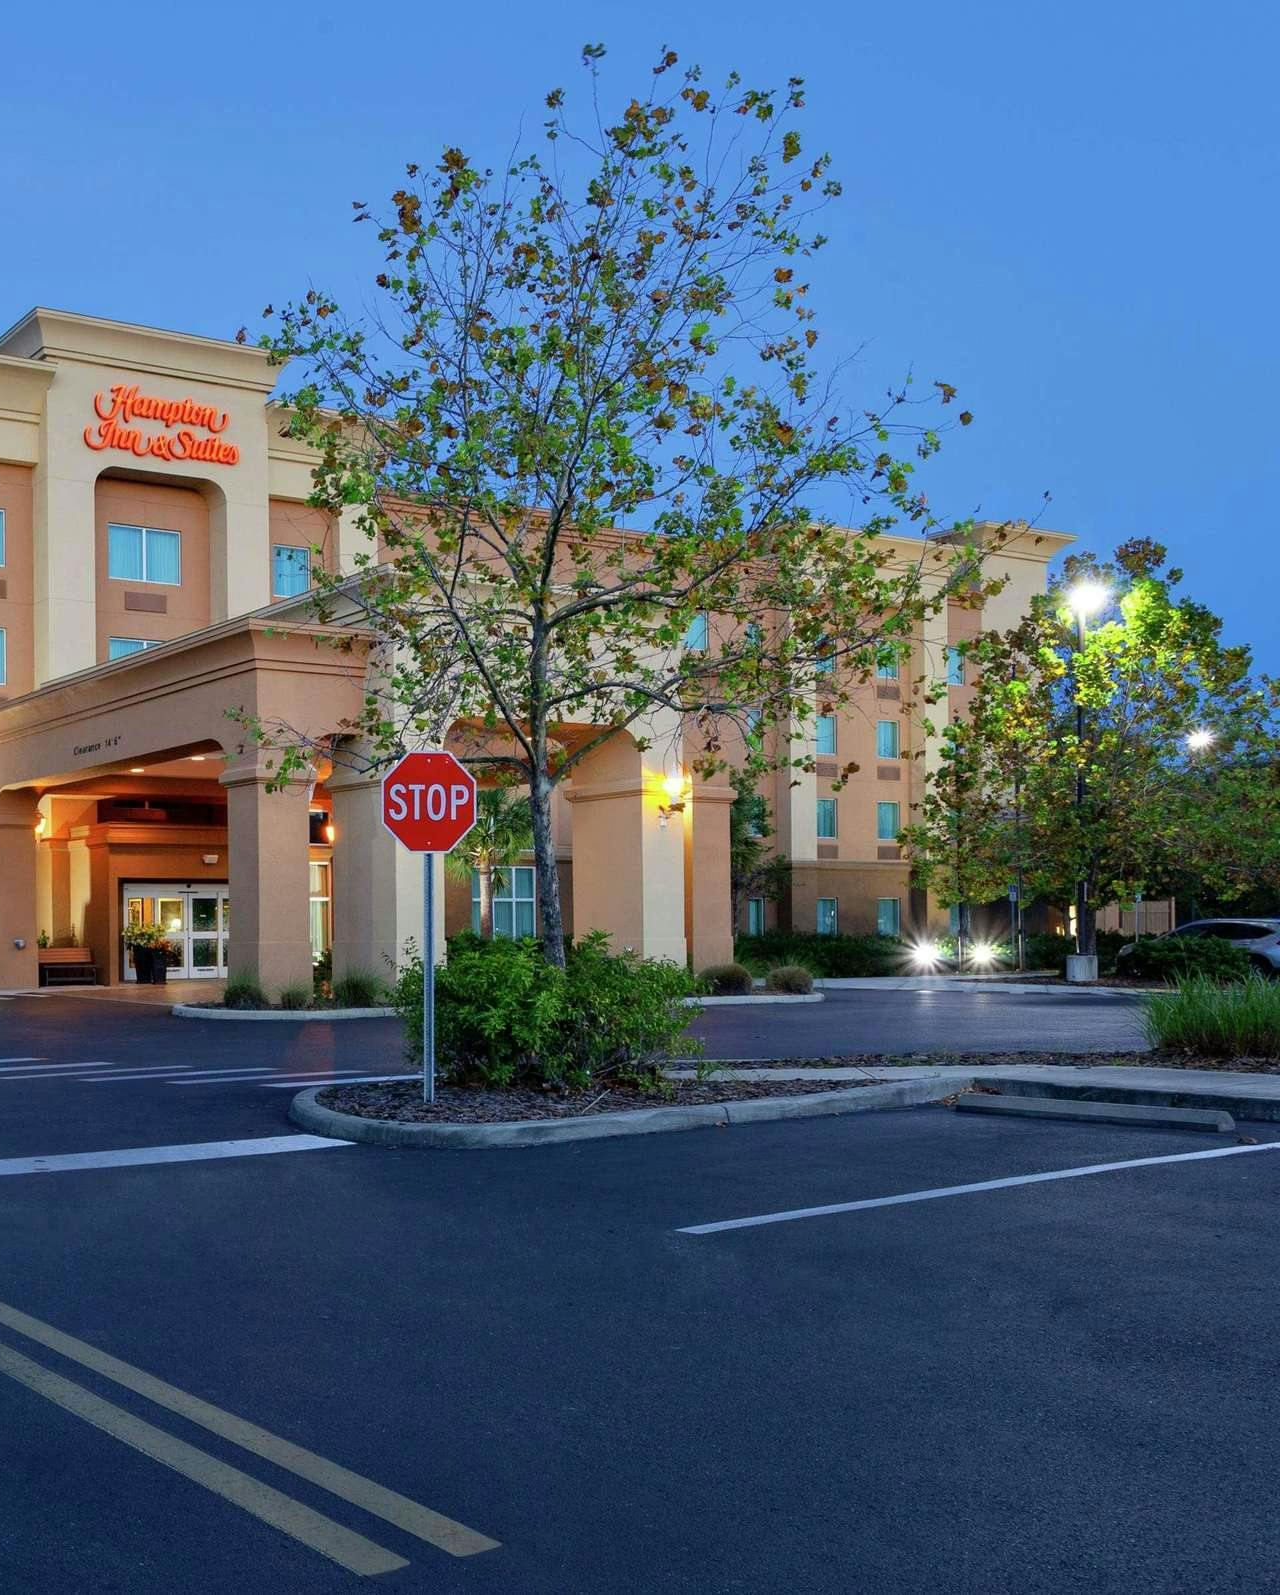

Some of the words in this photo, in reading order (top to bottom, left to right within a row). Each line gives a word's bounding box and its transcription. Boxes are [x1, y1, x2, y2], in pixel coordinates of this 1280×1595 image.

[94, 385, 228, 432] Hampton
[84, 420, 152, 456] Inn
[151, 435, 171, 461] &
[170, 430, 239, 465] Suites
[73, 743, 101, 756] Clearance
[388, 783, 470, 821] STOP
